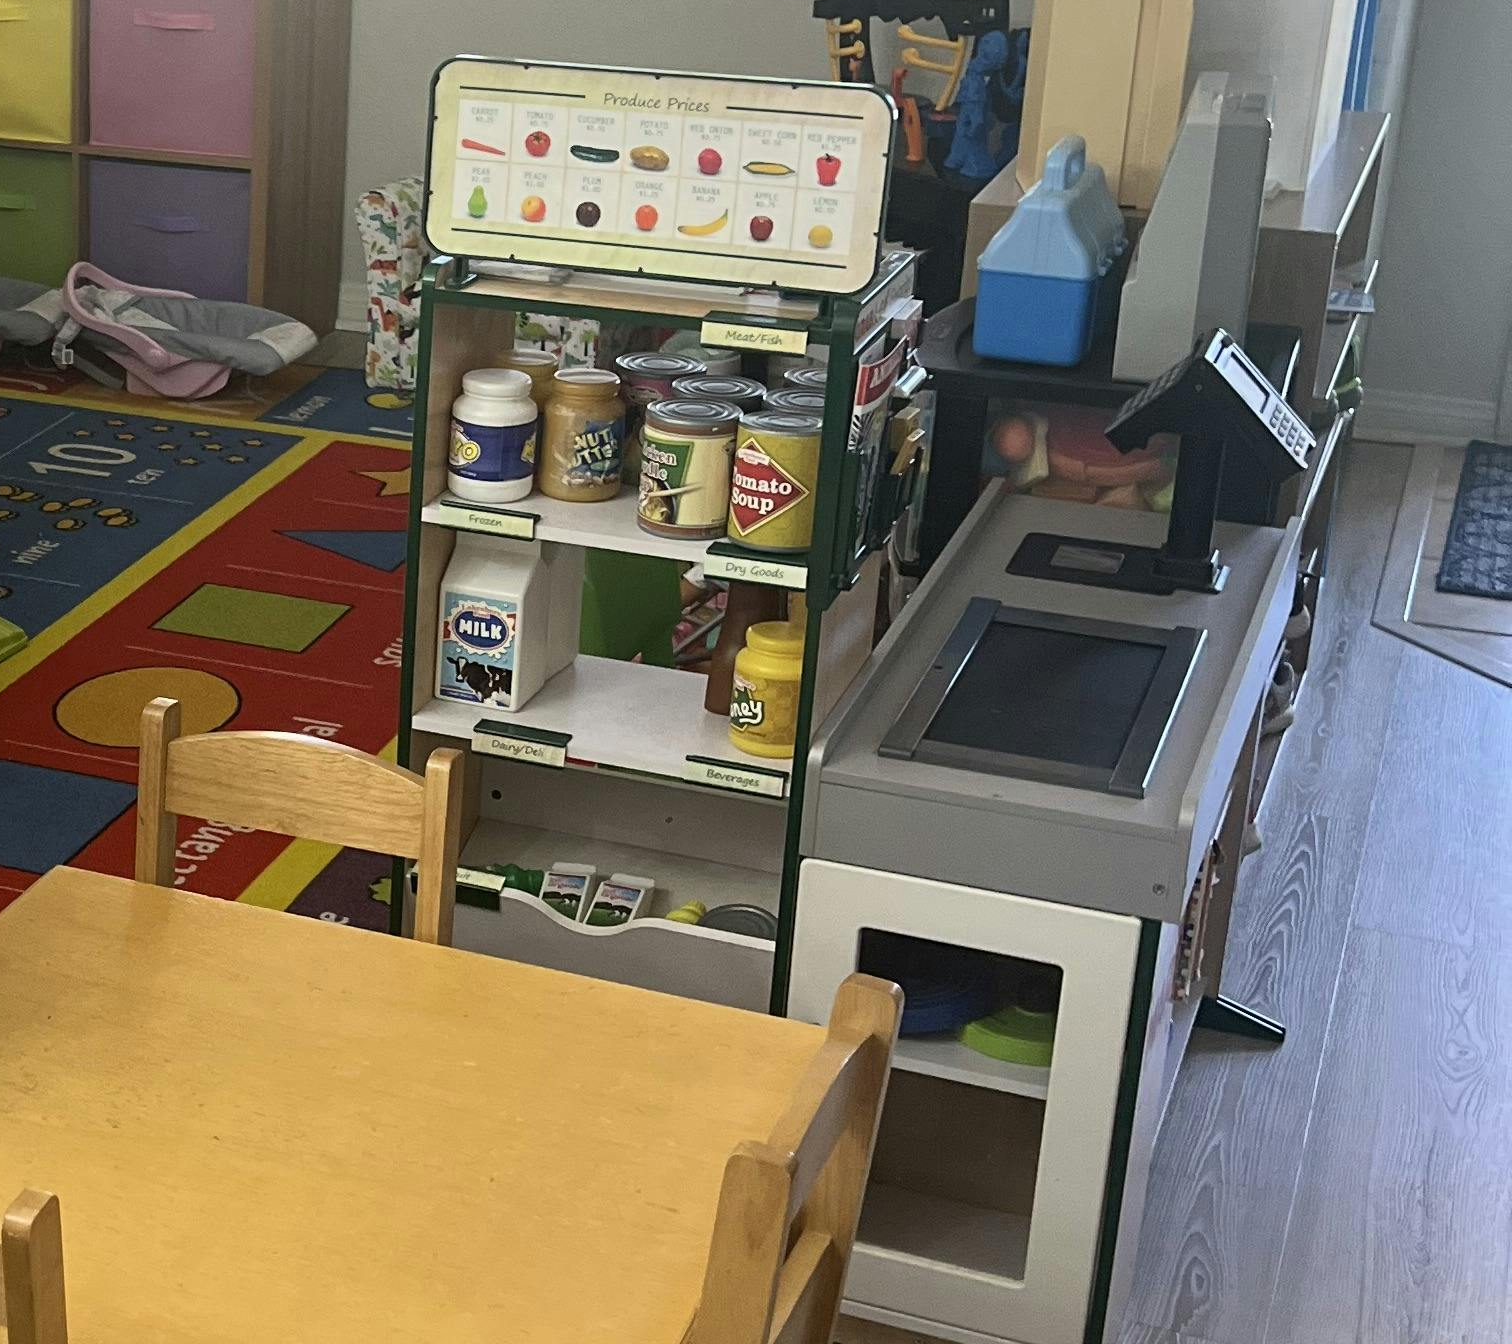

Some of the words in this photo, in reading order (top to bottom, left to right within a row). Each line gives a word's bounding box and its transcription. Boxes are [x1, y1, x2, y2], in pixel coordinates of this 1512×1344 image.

[604, 92, 661, 109] Produce
[667, 97, 710, 112] Prices
[471, 107, 499, 116] CARROT
[526, 111, 554, 121] TOMATO
[640, 120, 669, 129] POTATO
[472, 167, 490, 175] PEAR
[524, 172, 548, 181] PEACH
[635, 181, 664, 191] ORANGE
[692, 186, 720, 195] BANANA
[754, 191, 778, 201] APPLE
[813, 197, 838, 206] LEMON
[725, 330, 782, 345] Meat/Fish
[272, 395, 333, 422] lemon
[574, 428, 612, 448] NUT
[454, 439, 480, 461] YO
[28, 443, 136, 478] 10
[127, 468, 165, 484] ten
[731, 487, 774, 515] Soup
[469, 514, 502, 527] Frozen
[11, 540, 61, 565] nine
[726, 562, 746, 576] Dry
[750, 565, 784, 579] Goods
[459, 619, 502, 640] MILK
[730, 700, 763, 724] ney
[491, 739, 544, 756] Dairy/Deli
[706, 768, 760, 787] Beverages
